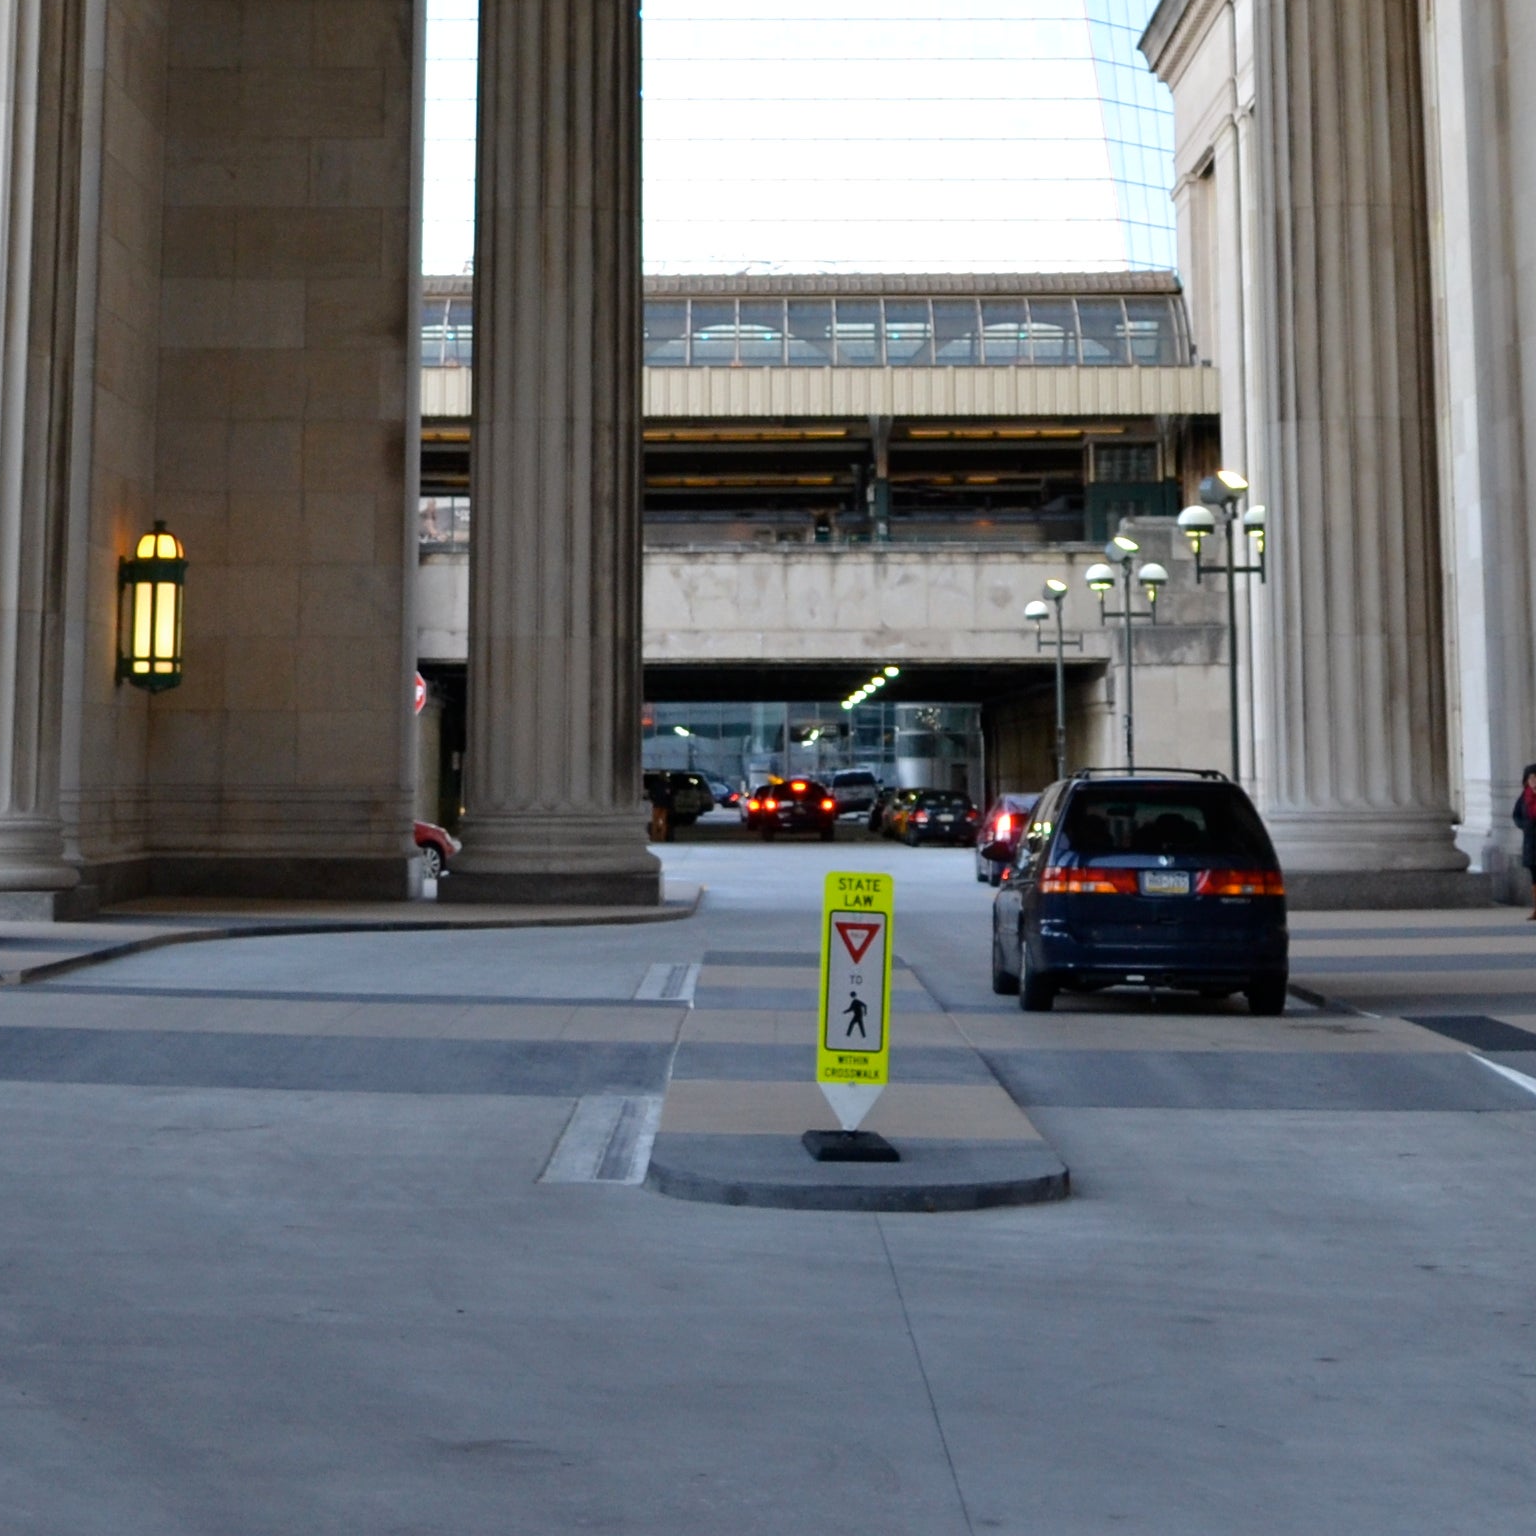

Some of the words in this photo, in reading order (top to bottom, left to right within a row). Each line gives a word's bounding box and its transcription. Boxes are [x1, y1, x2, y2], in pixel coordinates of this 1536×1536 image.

[838, 877, 881, 892] STATE
[844, 894, 874, 907] LAW
[850, 975, 863, 985] TO
[838, 1055, 869, 1065] WITHIN
[825, 1067, 880, 1080] CROSSWALK
